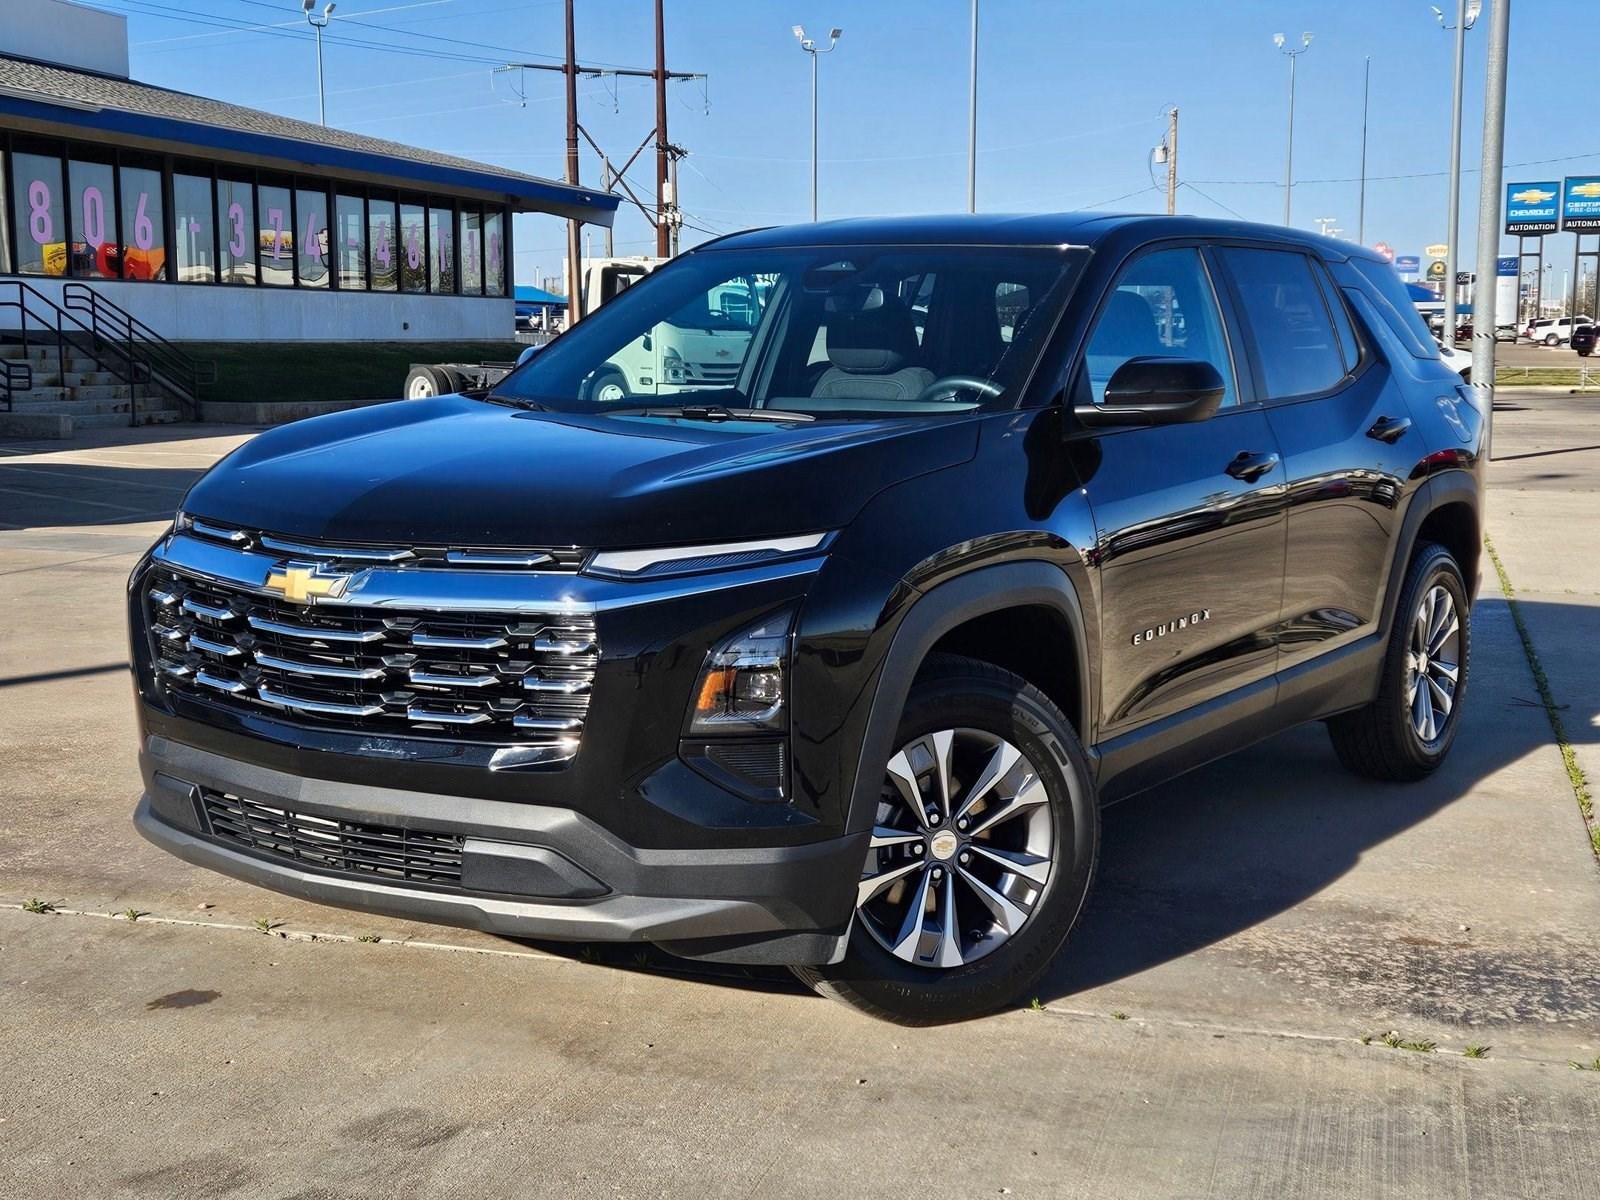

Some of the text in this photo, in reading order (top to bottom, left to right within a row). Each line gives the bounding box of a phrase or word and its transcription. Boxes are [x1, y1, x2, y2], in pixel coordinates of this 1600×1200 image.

[1510, 208, 1556, 216] CHEVROLET
[1509, 223, 1556, 231] AUTONATION
[1132, 609, 1210, 645] EQUINOX
